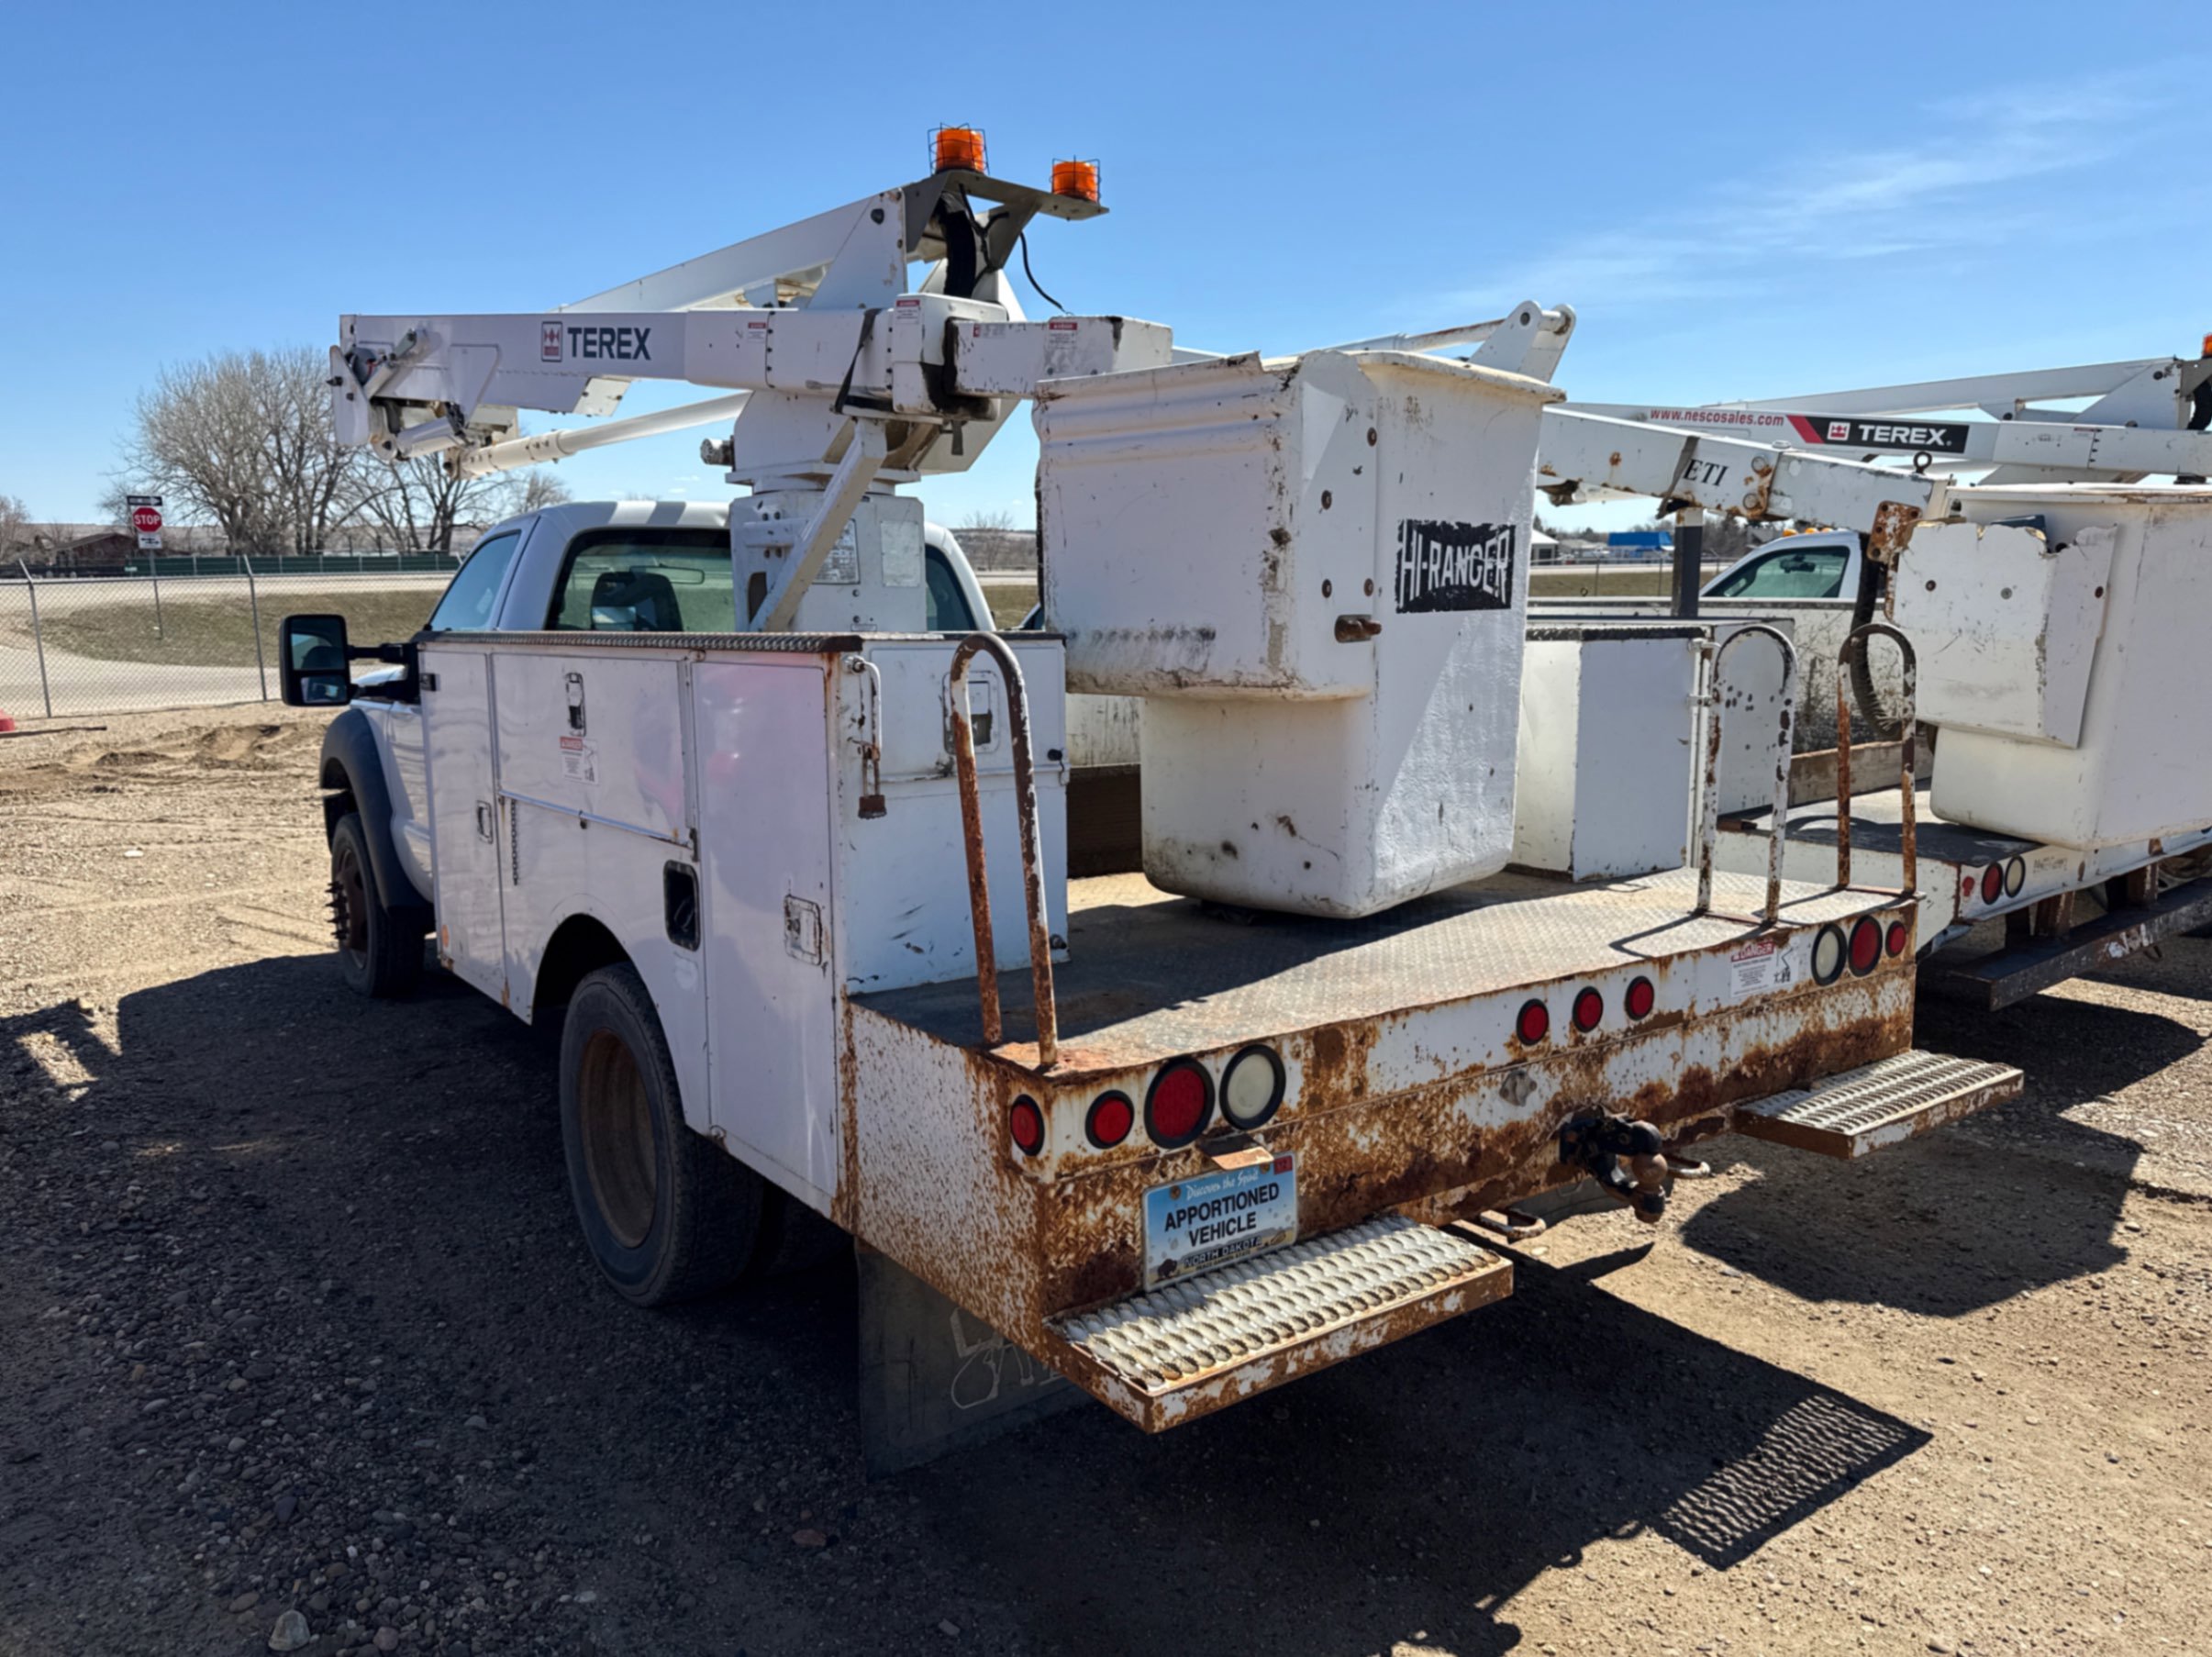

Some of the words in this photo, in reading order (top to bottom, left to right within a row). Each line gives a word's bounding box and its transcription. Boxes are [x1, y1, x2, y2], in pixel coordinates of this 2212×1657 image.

[567, 327, 651, 361] TEREX
[1650, 409, 1784, 427] www.nescosales.com
[1859, 424, 1949, 446] TEREX
[1683, 458, 1729, 486] ETI
[134, 515, 161, 525] STOP
[1398, 518, 1510, 609] HI-RANGER
[1164, 1182, 1280, 1232] APPORTIONED
[1188, 1211, 1257, 1248] VEHICLE
[1184, 1251, 1219, 1267] NORTH
[1221, 1237, 1262, 1255] DAKOTA
